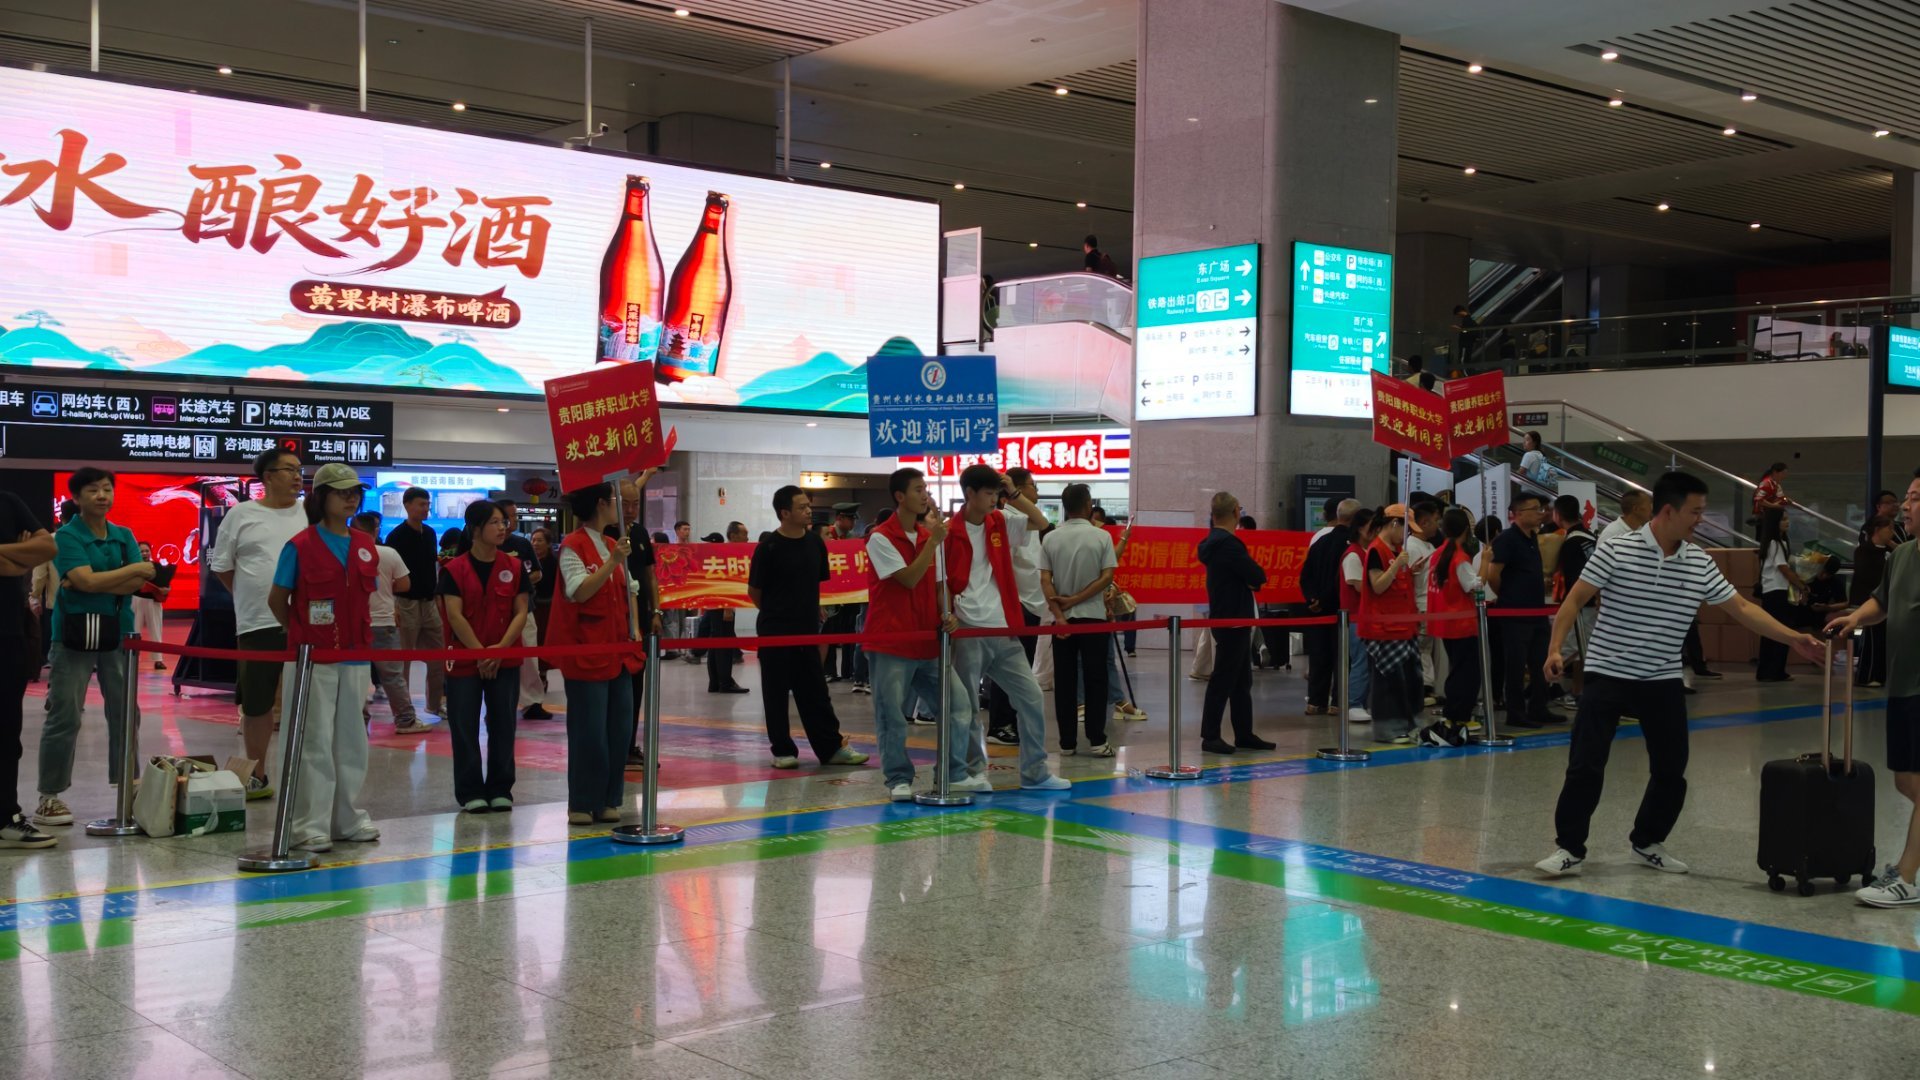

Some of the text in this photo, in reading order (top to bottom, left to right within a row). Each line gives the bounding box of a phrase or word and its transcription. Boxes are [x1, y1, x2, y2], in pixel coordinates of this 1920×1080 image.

[182, 154, 552, 279] 酿好酒
[1198, 259, 1230, 276] 东广场
[303, 283, 512, 324] 黄果树瀑布啤酒
[1147, 293, 1196, 310] 铁路出站口
[179, 399, 235, 416] 长途汽车
[559, 388, 650, 426] 贵阳康养职业大学
[1377, 390, 1444, 426] 贵阳康养职业大学
[1450, 391, 1502, 414] 贵阳康养职业大学
[62, 410, 92, 420] E-hailing
[180, 415, 209, 424] Inter-city
[210, 416, 231, 425] Coach
[269, 418, 293, 428] Parking
[875, 417, 995, 446] 欢迎新同学
[1453, 409, 1504, 438] 欢迎新同学
[121, 434, 346, 453] 无障碍电梯 咨询服务 卫生间
[565, 417, 654, 461] 欢迎新同学
[1379, 413, 1444, 451] 欢迎新同学
[129, 450, 163, 458] Accessible
[164, 451, 191, 459] Elevator
[314, 454, 346, 462] Restrooms
[1028, 438, 1099, 471] 便利店
[411, 475, 474, 486] 旅游咨询服务台
[1376, 884, 1486, 909] Square
[1483, 906, 1564, 926] West
